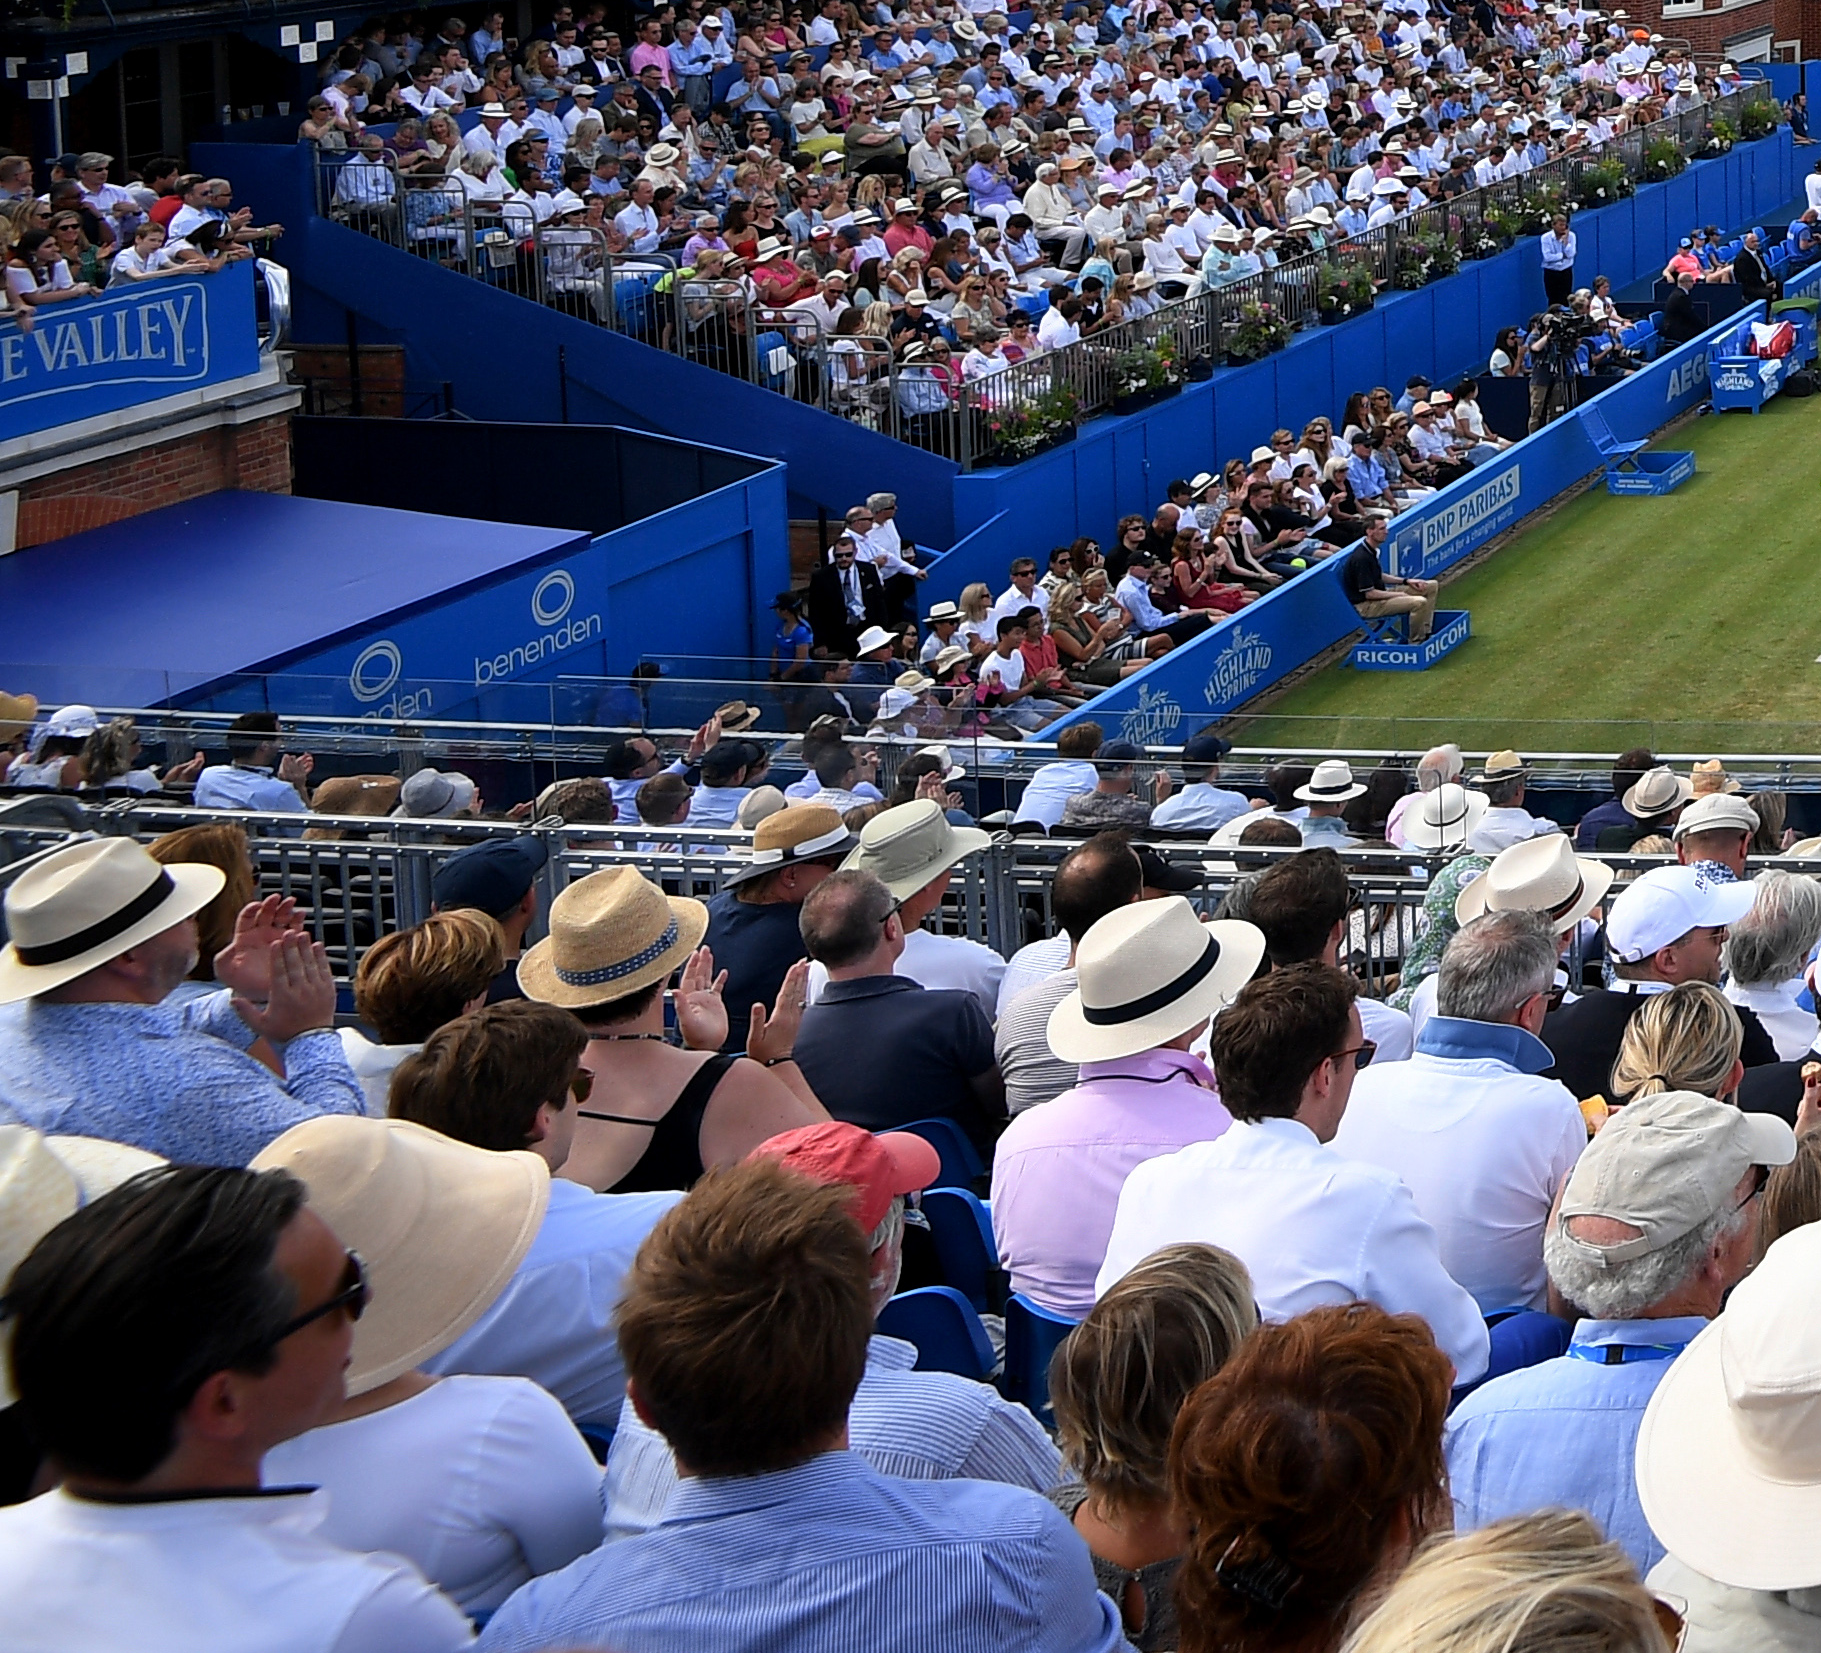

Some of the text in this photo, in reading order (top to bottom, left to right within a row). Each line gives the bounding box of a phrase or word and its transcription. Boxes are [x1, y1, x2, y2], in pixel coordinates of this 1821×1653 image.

[32, 295, 193, 372] VALLEY
[1666, 352, 1710, 403] AEG
[1715, 376, 1754, 389] HIGHLAND
[1427, 473, 1513, 548] BNP PARIBAS
[1427, 555, 1439, 569] The
[1440, 543, 1454, 560] bank
[1454, 538, 1465, 554] for
[1471, 517, 1497, 542] changing
[1497, 504, 1514, 523] world
[474, 614, 601, 687] benenden
[1357, 650, 1417, 664] RICOH
[1425, 619, 1467, 662] RICOH
[1204, 646, 1272, 705] HIGHLAND
[1222, 671, 1257, 704] SPRING
[1125, 704, 1181, 745] GHLAND
